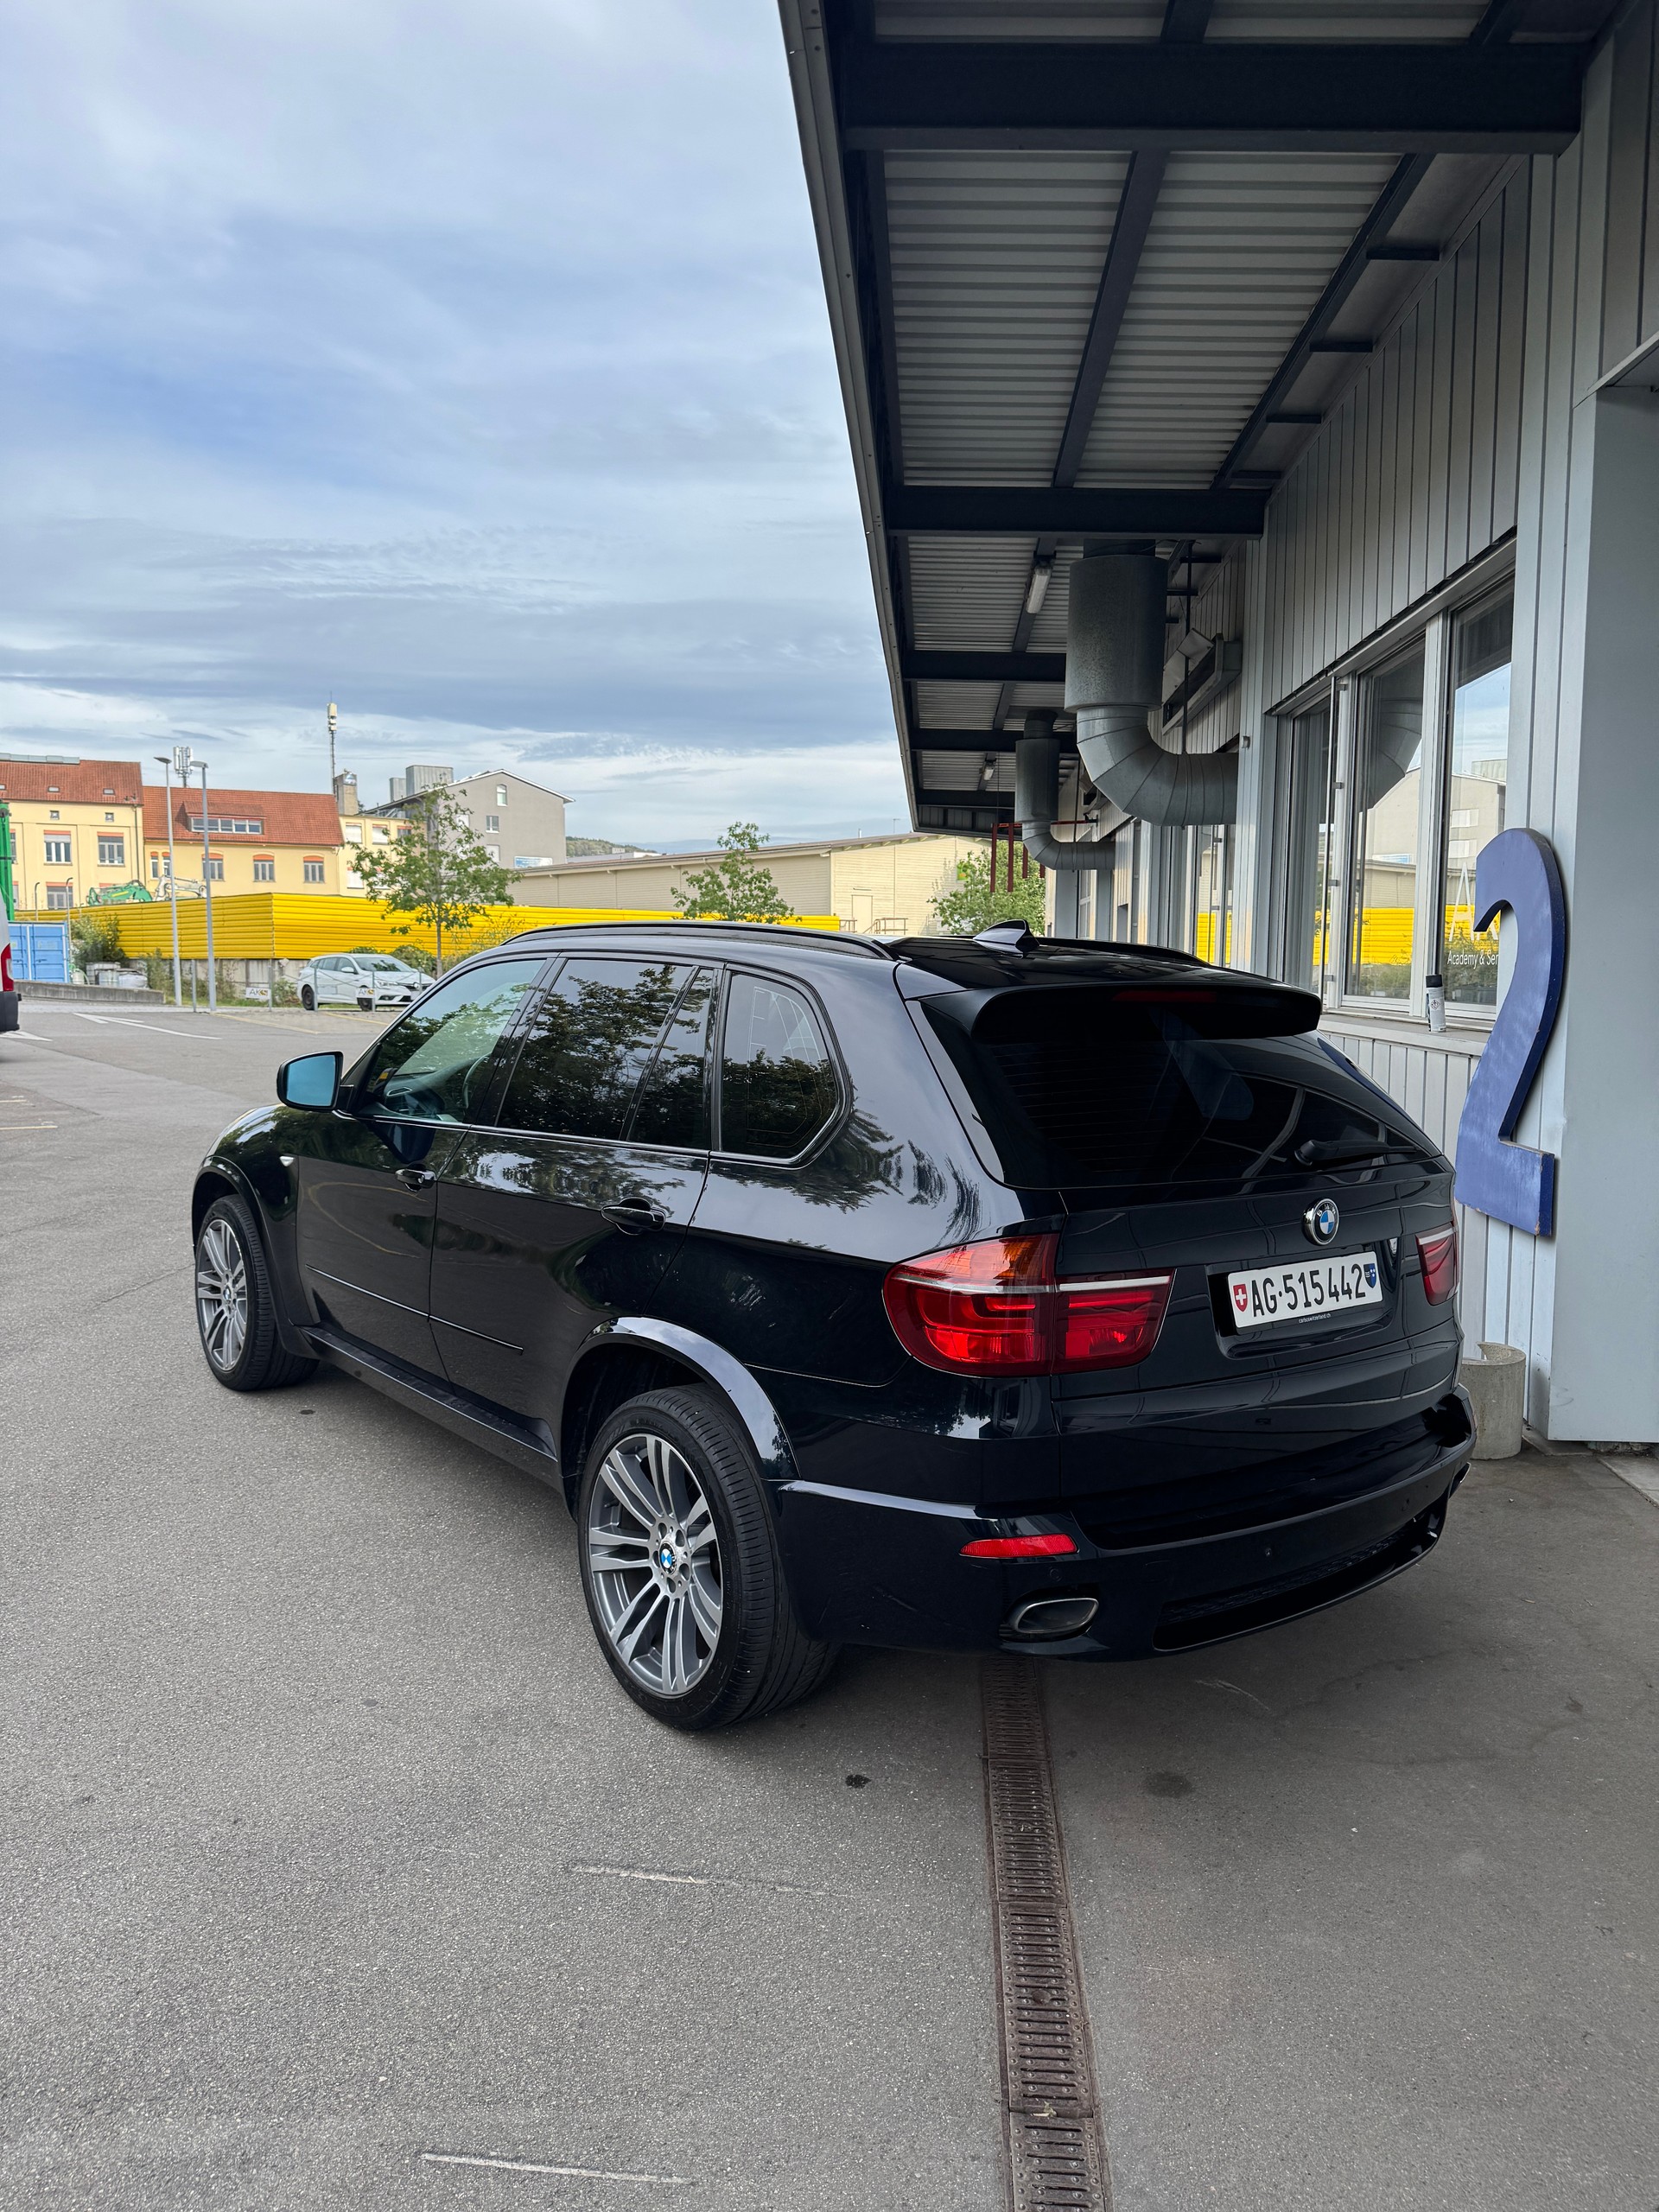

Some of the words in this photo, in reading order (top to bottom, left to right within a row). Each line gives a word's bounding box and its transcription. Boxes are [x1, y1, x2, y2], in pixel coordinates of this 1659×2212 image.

[1447, 950, 1478, 969] Academy
[1479, 949, 1485, 965] &
[1455, 828, 1565, 1236] 2
[1316, 1204, 1336, 1217] BMW
